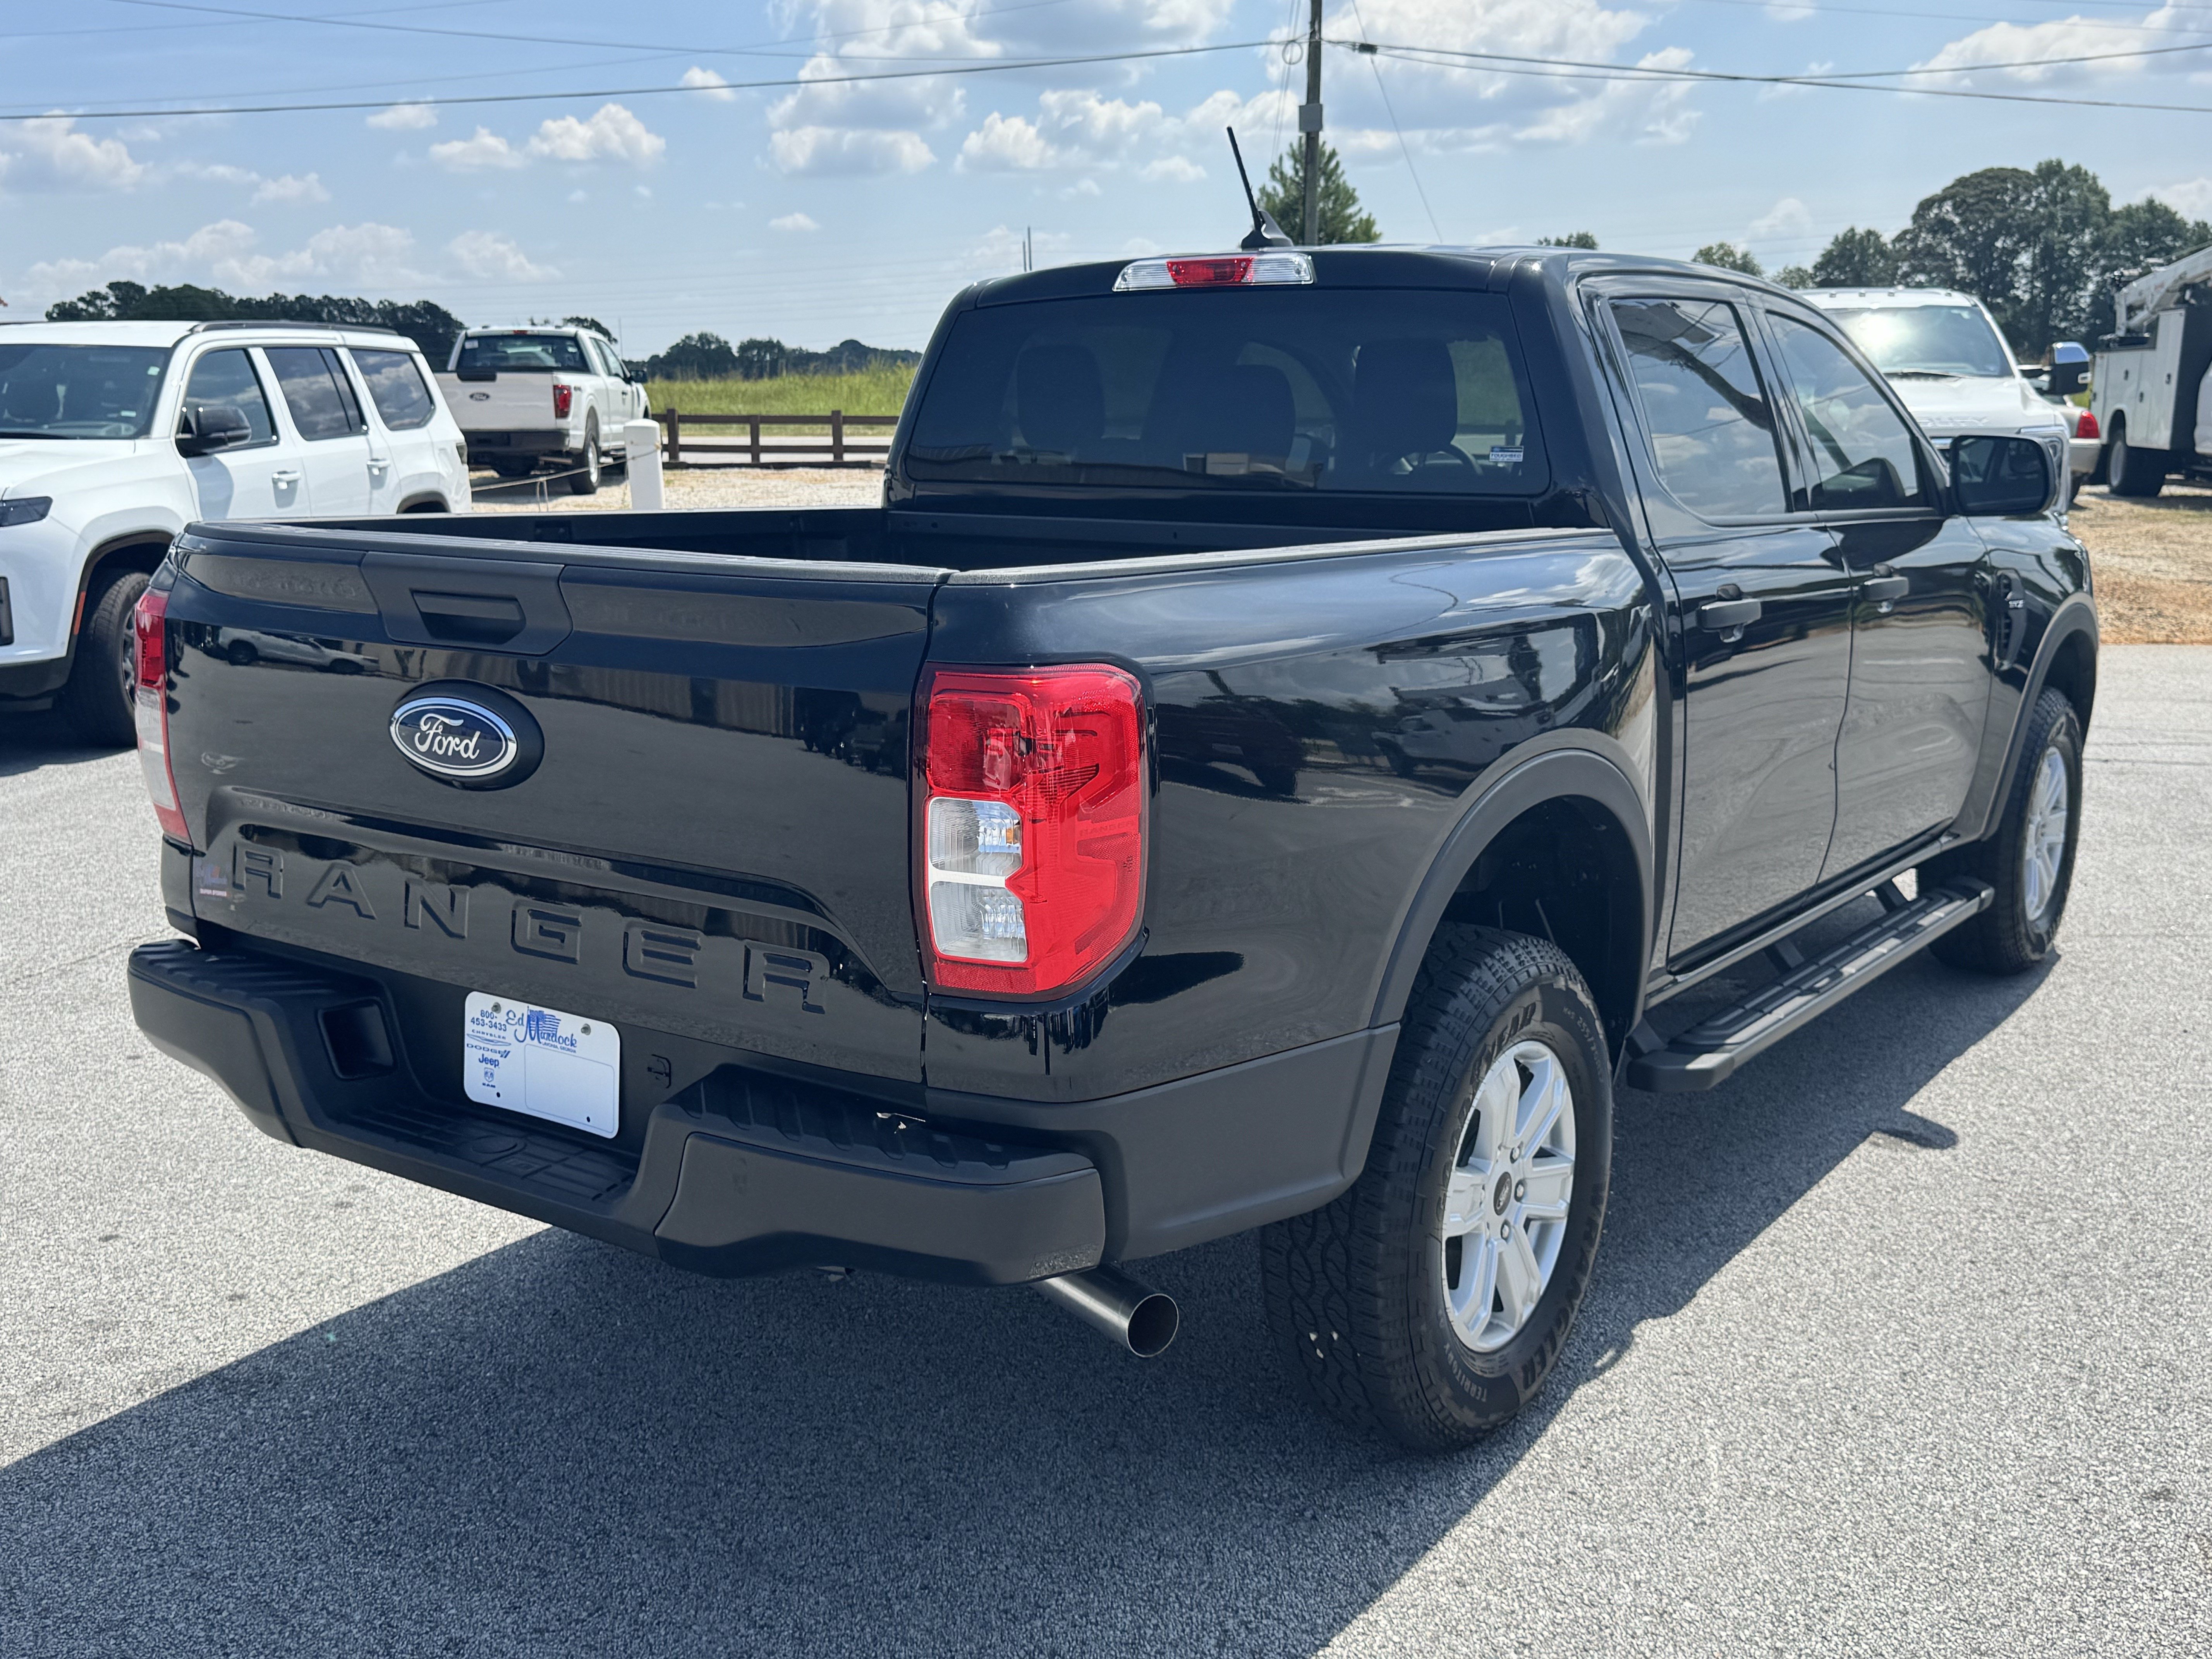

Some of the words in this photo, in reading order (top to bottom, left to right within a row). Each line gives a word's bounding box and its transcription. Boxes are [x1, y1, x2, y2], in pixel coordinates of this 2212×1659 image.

[414, 713, 481, 759] Ford
[232, 840, 830, 1014] RANGER
[471, 1017, 507, 1031] 453-3433
[505, 1010, 524, 1026] Ed
[514, 1011, 577, 1047] Murdock
[472, 1029, 506, 1039] CHRYSLER
[479, 1053, 500, 1068] Jeep
[1443, 1342, 1487, 1402] TERRITORY
